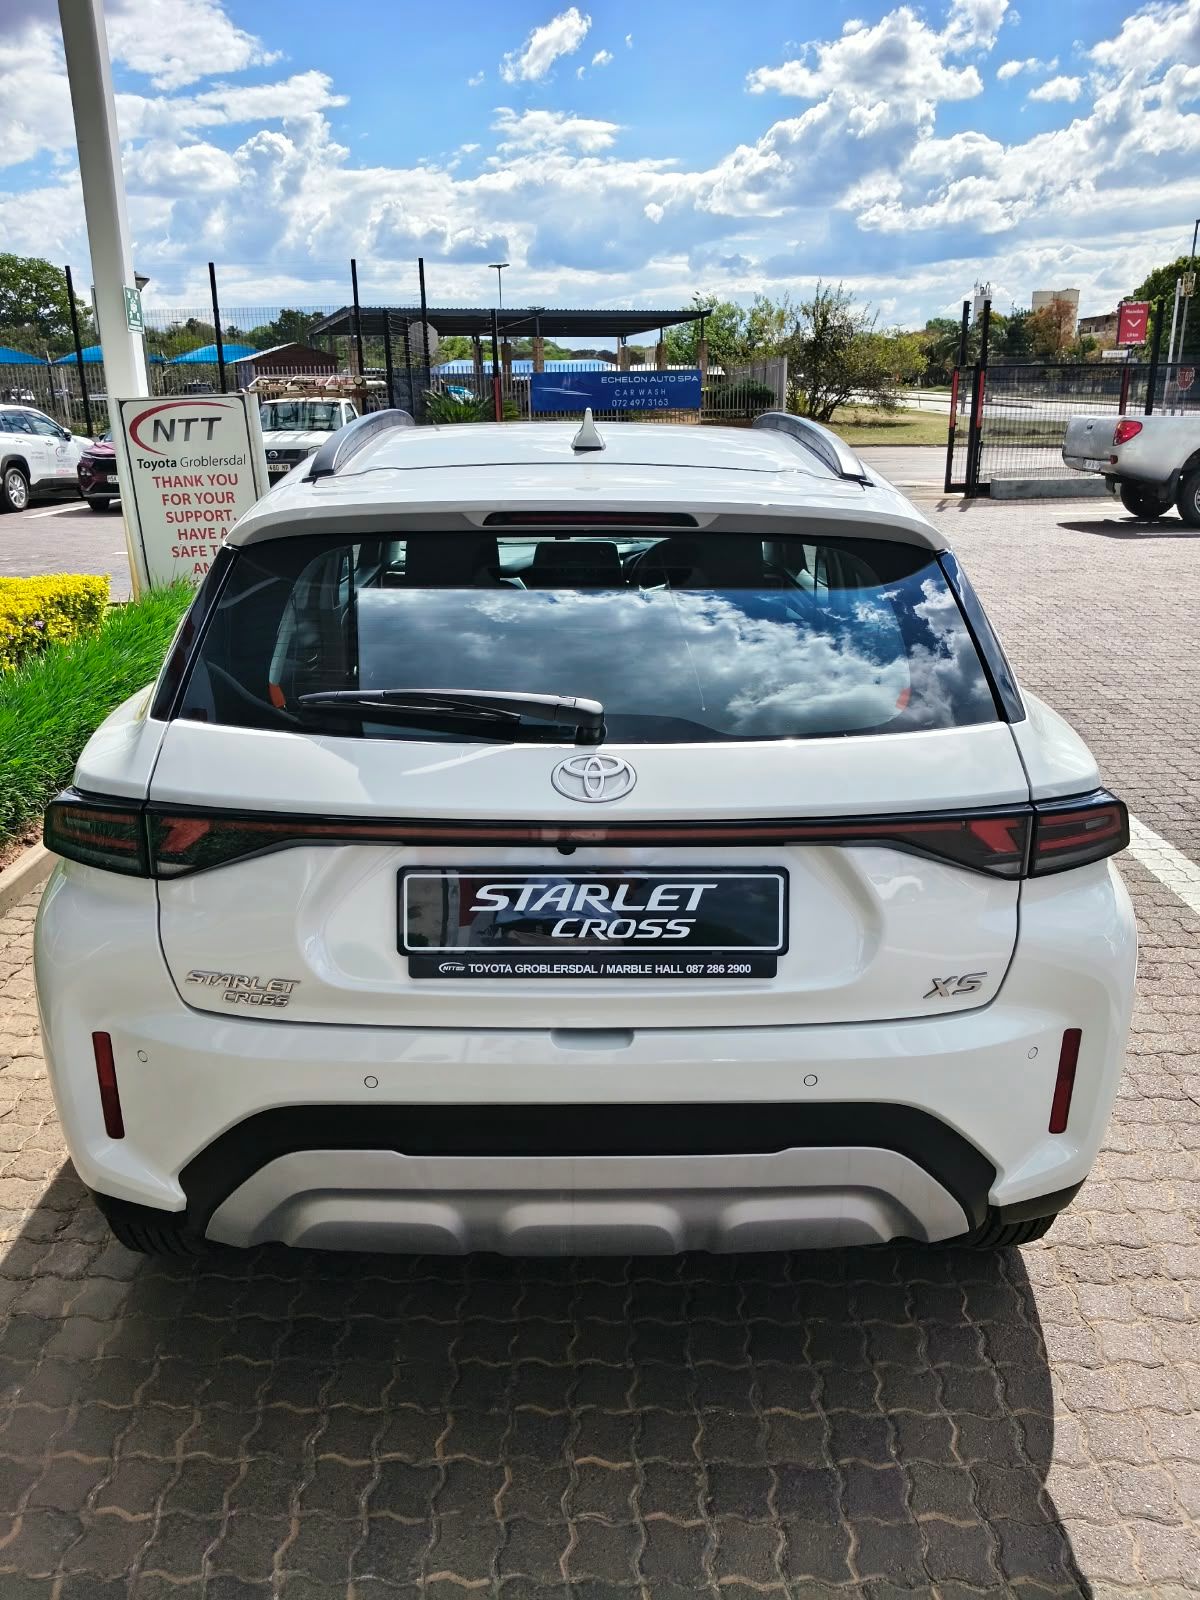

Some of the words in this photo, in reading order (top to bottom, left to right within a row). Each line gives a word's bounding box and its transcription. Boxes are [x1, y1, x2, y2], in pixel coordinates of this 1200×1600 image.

[601, 376, 648, 384] ECHELON
[649, 375, 676, 383] AUTO
[677, 375, 699, 383] SPA
[614, 389, 635, 397] CAR
[639, 388, 666, 396] WASH
[611, 399, 627, 407] 072
[630, 399, 646, 407] 497
[648, 398, 669, 406] 3163
[152, 416, 222, 442] NTT
[137, 458, 177, 471] Toyota
[180, 454, 246, 468] Groblersdal
[152, 474, 204, 489] THANK
[207, 473, 239, 487] YOU
[161, 493, 191, 506] FOR
[194, 491, 236, 504] YOUR
[165, 509, 237, 524] SUPPORT.
[177, 527, 217, 541] HAVE
[220, 527, 229, 539] A
[171, 545, 208, 558] SAFE
[469, 883, 718, 912] STARLET
[551, 918, 697, 940] CROSS
[468, 963, 513, 974] TOYOTA
[514, 964, 598, 974] GROBLERSDAL
[600, 964, 604, 974] /
[606, 964, 652, 974] MARBLE
[655, 964, 684, 974] HALL
[686, 964, 704, 974] 087
[707, 964, 725, 974] 286
[727, 964, 751, 974] 2900
[185, 969, 301, 993] STARLET
[922, 971, 988, 999] XS
[222, 989, 290, 1007] CROSS
